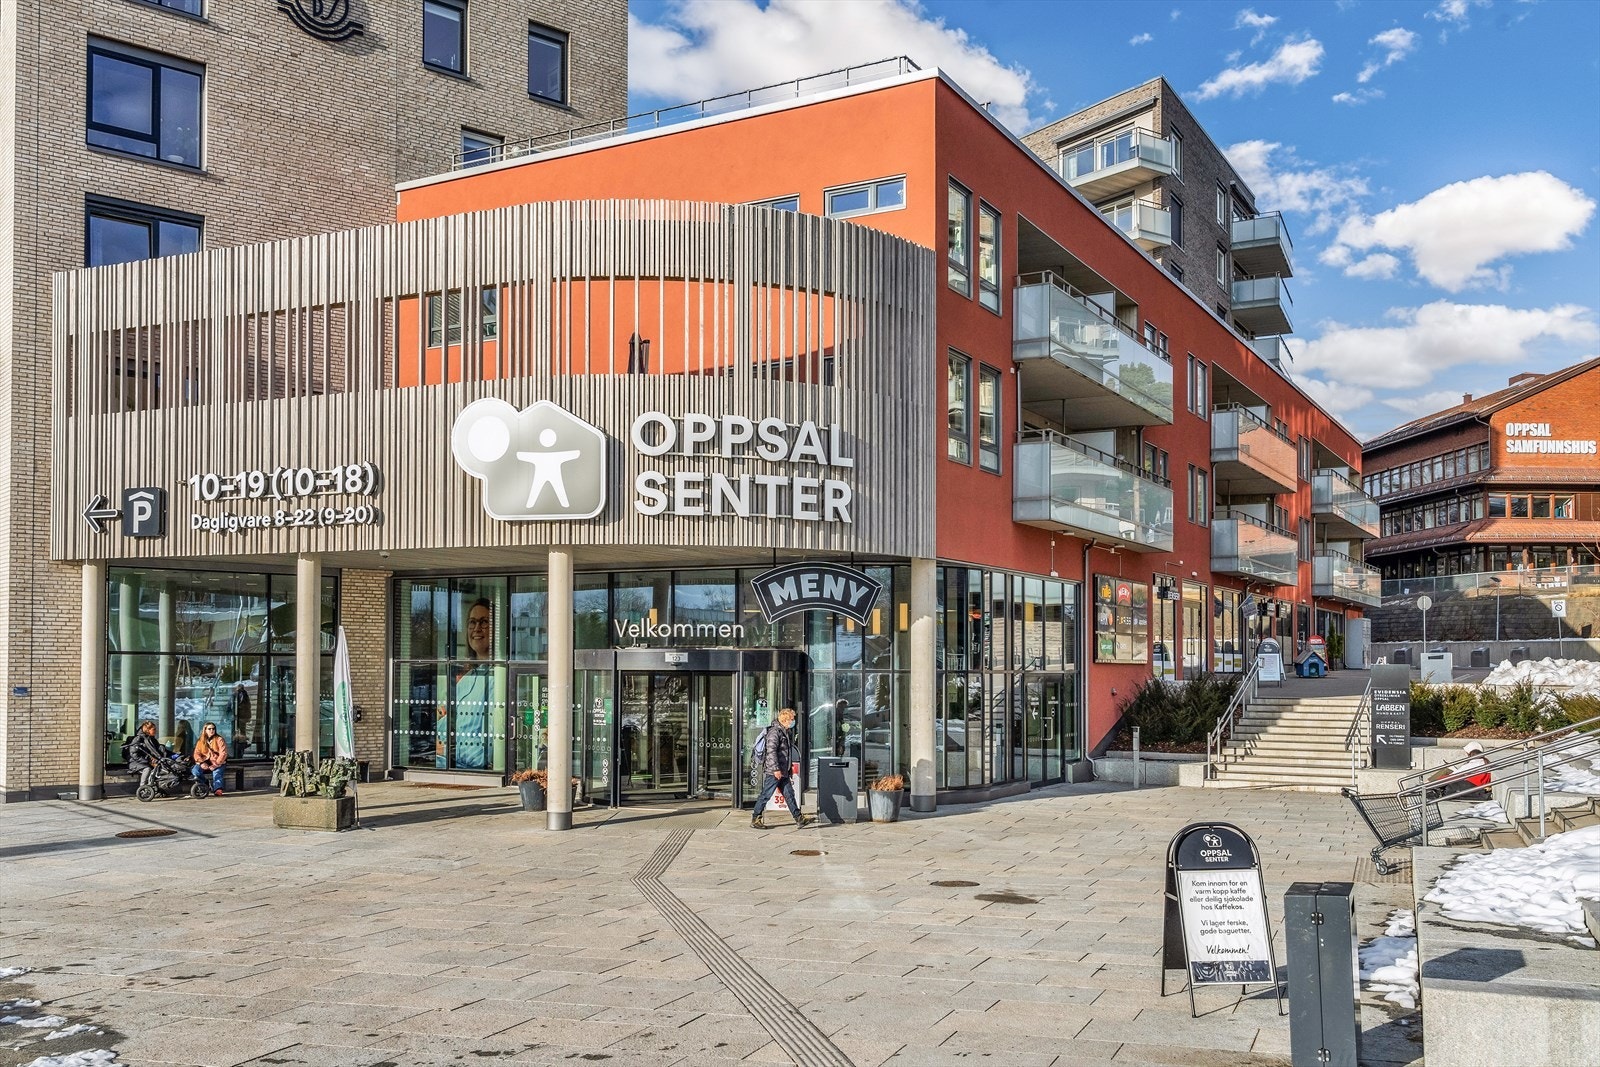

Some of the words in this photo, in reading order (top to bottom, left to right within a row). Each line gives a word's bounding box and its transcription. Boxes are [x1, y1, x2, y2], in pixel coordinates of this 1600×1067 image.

[631, 411, 854, 467] OPPSAL
[1505, 422, 1552, 437] OPPSAL
[1506, 439, 1597, 454] SAMFUNNSHUS
[189, 470, 266, 501] 10-19
[272, 461, 375, 500] (10-18)
[634, 470, 852, 523] SENTER
[132, 501, 152, 533] P
[191, 512, 271, 533] Dagligvare
[275, 509, 314, 526] 8-22
[318, 504, 374, 526] (9-20)
[768, 573, 869, 607] MENY
[614, 618, 744, 638] Velkommen
[1224, 895, 1253, 904] sjokolade
[1206, 944, 1250, 954] Velkommen!
